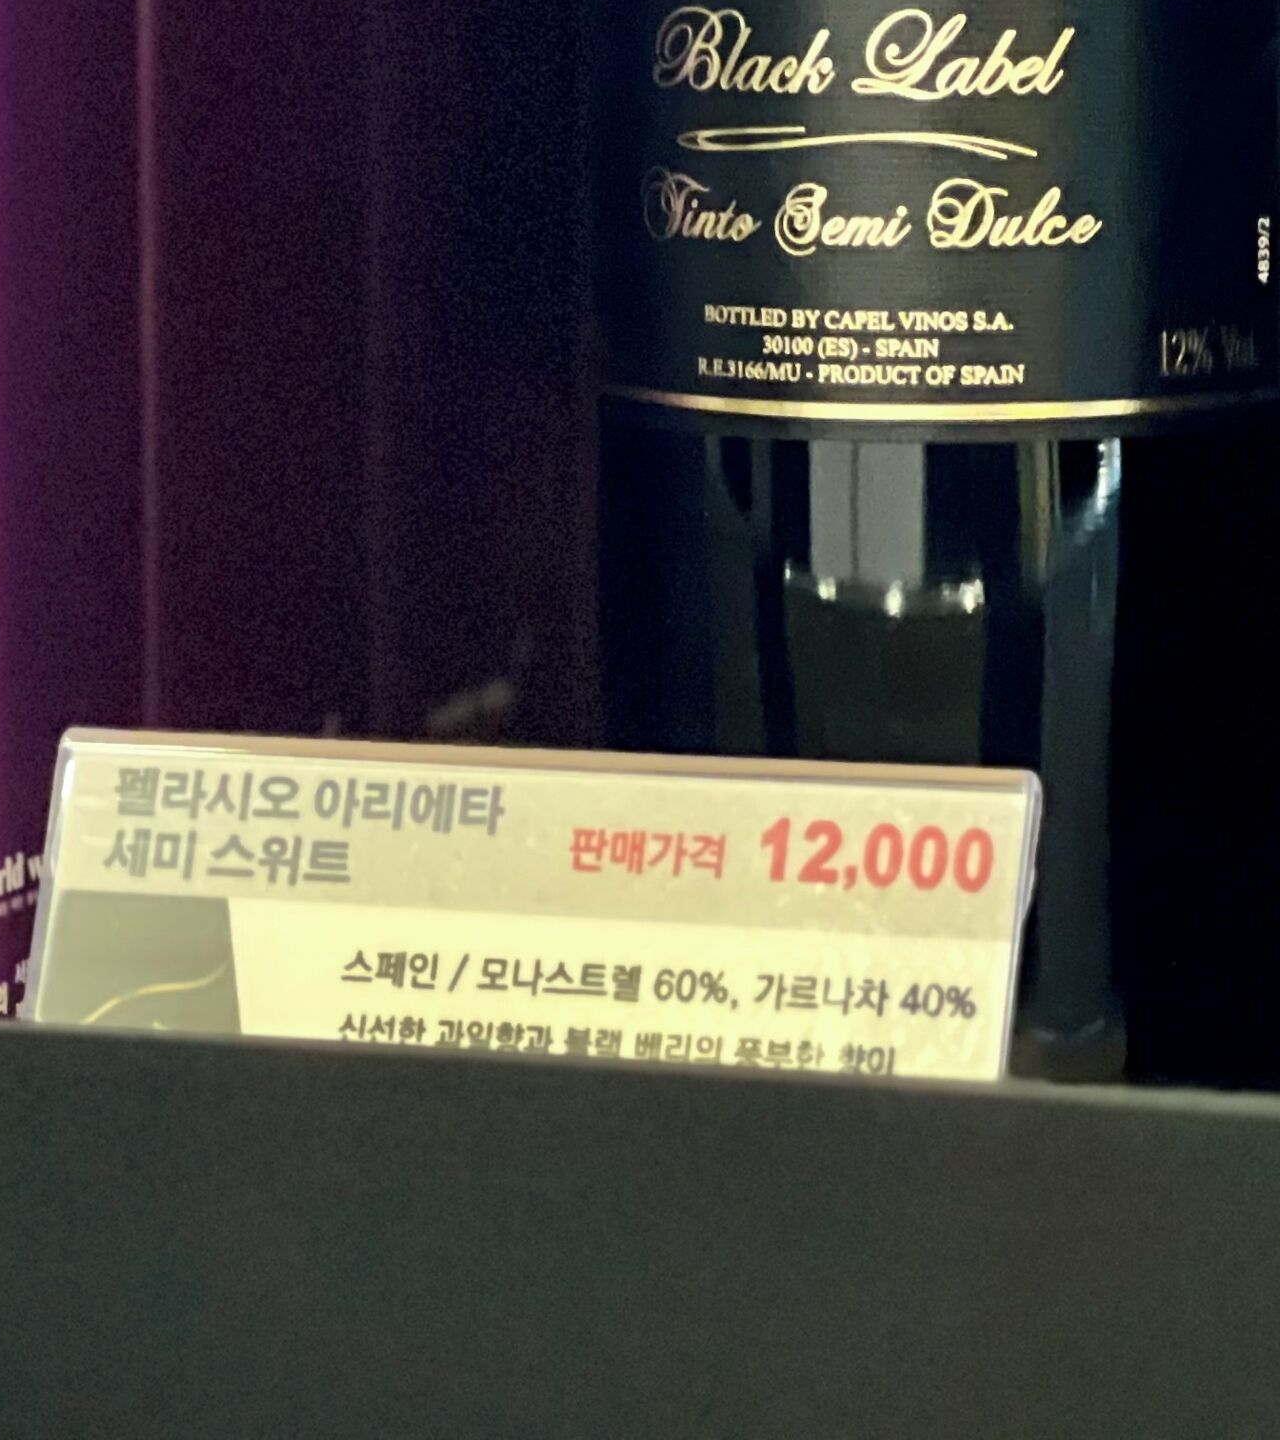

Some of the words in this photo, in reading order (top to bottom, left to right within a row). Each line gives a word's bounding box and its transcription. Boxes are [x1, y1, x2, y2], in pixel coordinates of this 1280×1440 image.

[654, 6, 836, 95] Black
[851, 8, 1076, 102] Label
[642, 164, 762, 244] Tinto
[774, 182, 912, 257] Semi
[927, 176, 1104, 248] Dulce
[1257, 217, 1271, 284] 4839/2
[704, 305, 788, 328] BOTTLED
[791, 308, 821, 330] BY
[824, 310, 895, 331] CAPEL
[898, 311, 969, 332] VINOS
[972, 311, 1014, 332] S.A.
[762, 335, 814, 356] 30100
[817, 336, 859, 360] (ES)
[875, 338, 940, 359] SPAIN
[818, 364, 921, 385] PRODUCT
[924, 365, 956, 386] OF
[960, 363, 1025, 386] SPAIN
[1161, 326, 1213, 376] 12%
[314, 777, 506, 836] 아리에타
[104, 827, 198, 881] 세미
[206, 833, 351, 886] 스위트
[569, 826, 727, 879] 판매가격
[760, 817, 995, 893] 12,000
[341, 949, 440, 991] 스페인
[447, 952, 470, 993] /
[475, 956, 642, 1003] 모나스트렐
[653, 968, 739, 1010] 60%,
[754, 972, 890, 1017] 가르나차
[899, 982, 977, 1020] 40%
